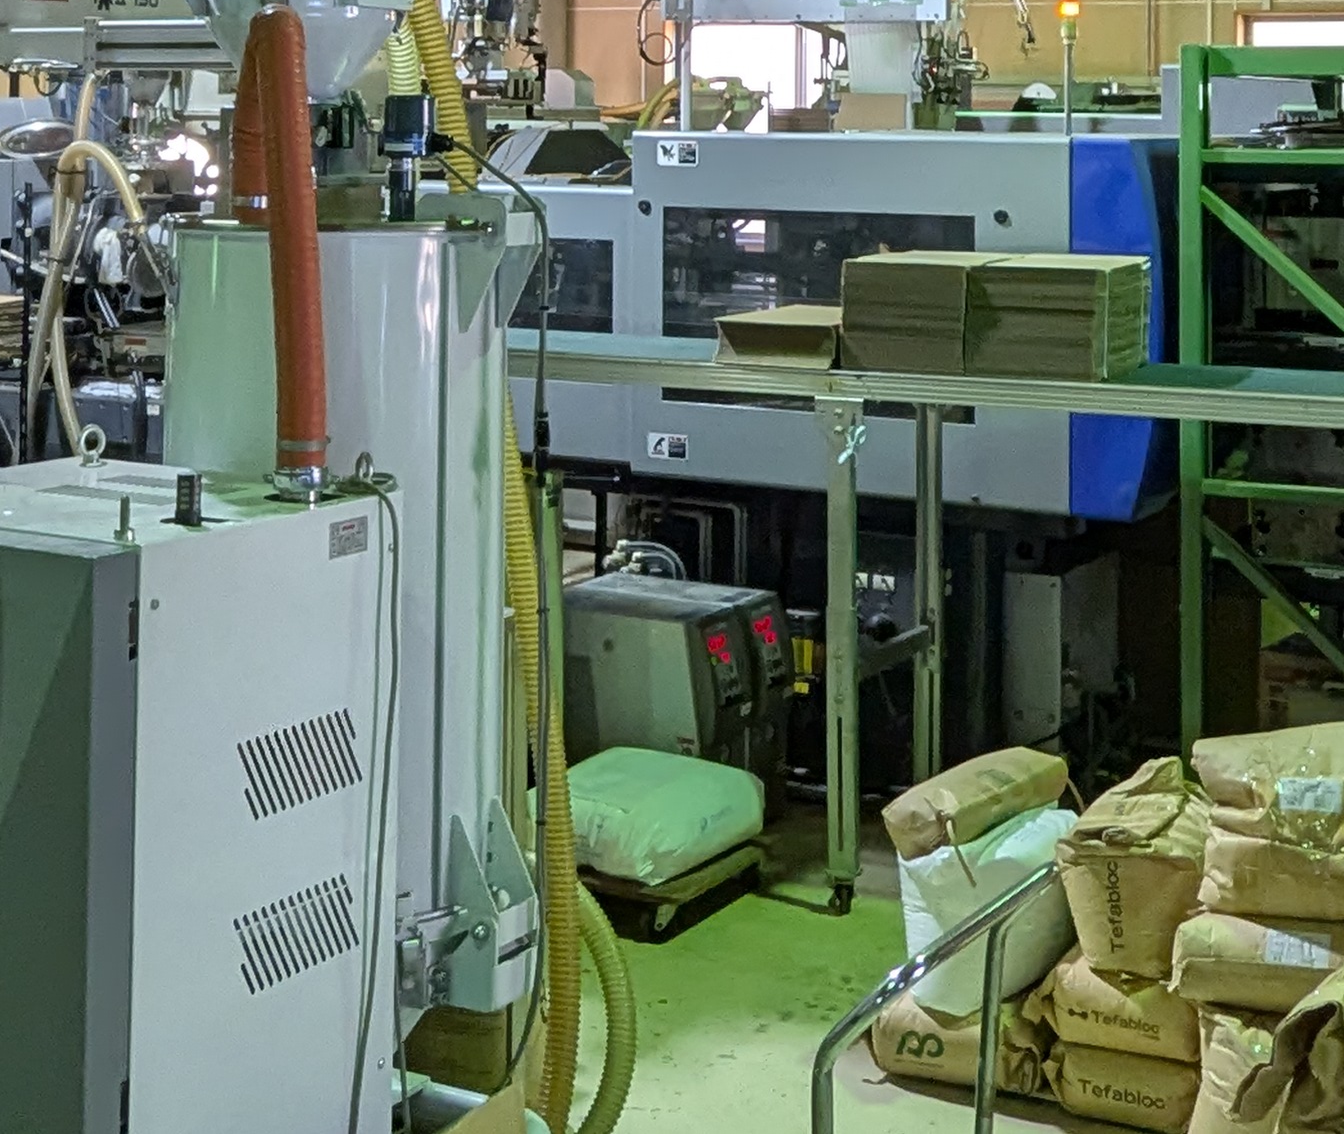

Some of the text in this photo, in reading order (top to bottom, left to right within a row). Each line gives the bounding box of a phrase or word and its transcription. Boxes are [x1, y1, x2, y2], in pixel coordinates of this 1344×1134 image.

[1106, 861, 1125, 954] Tefabloc
[1090, 1010, 1160, 1035] Tefabloc
[1077, 1078, 1166, 1110] Tefabloc
